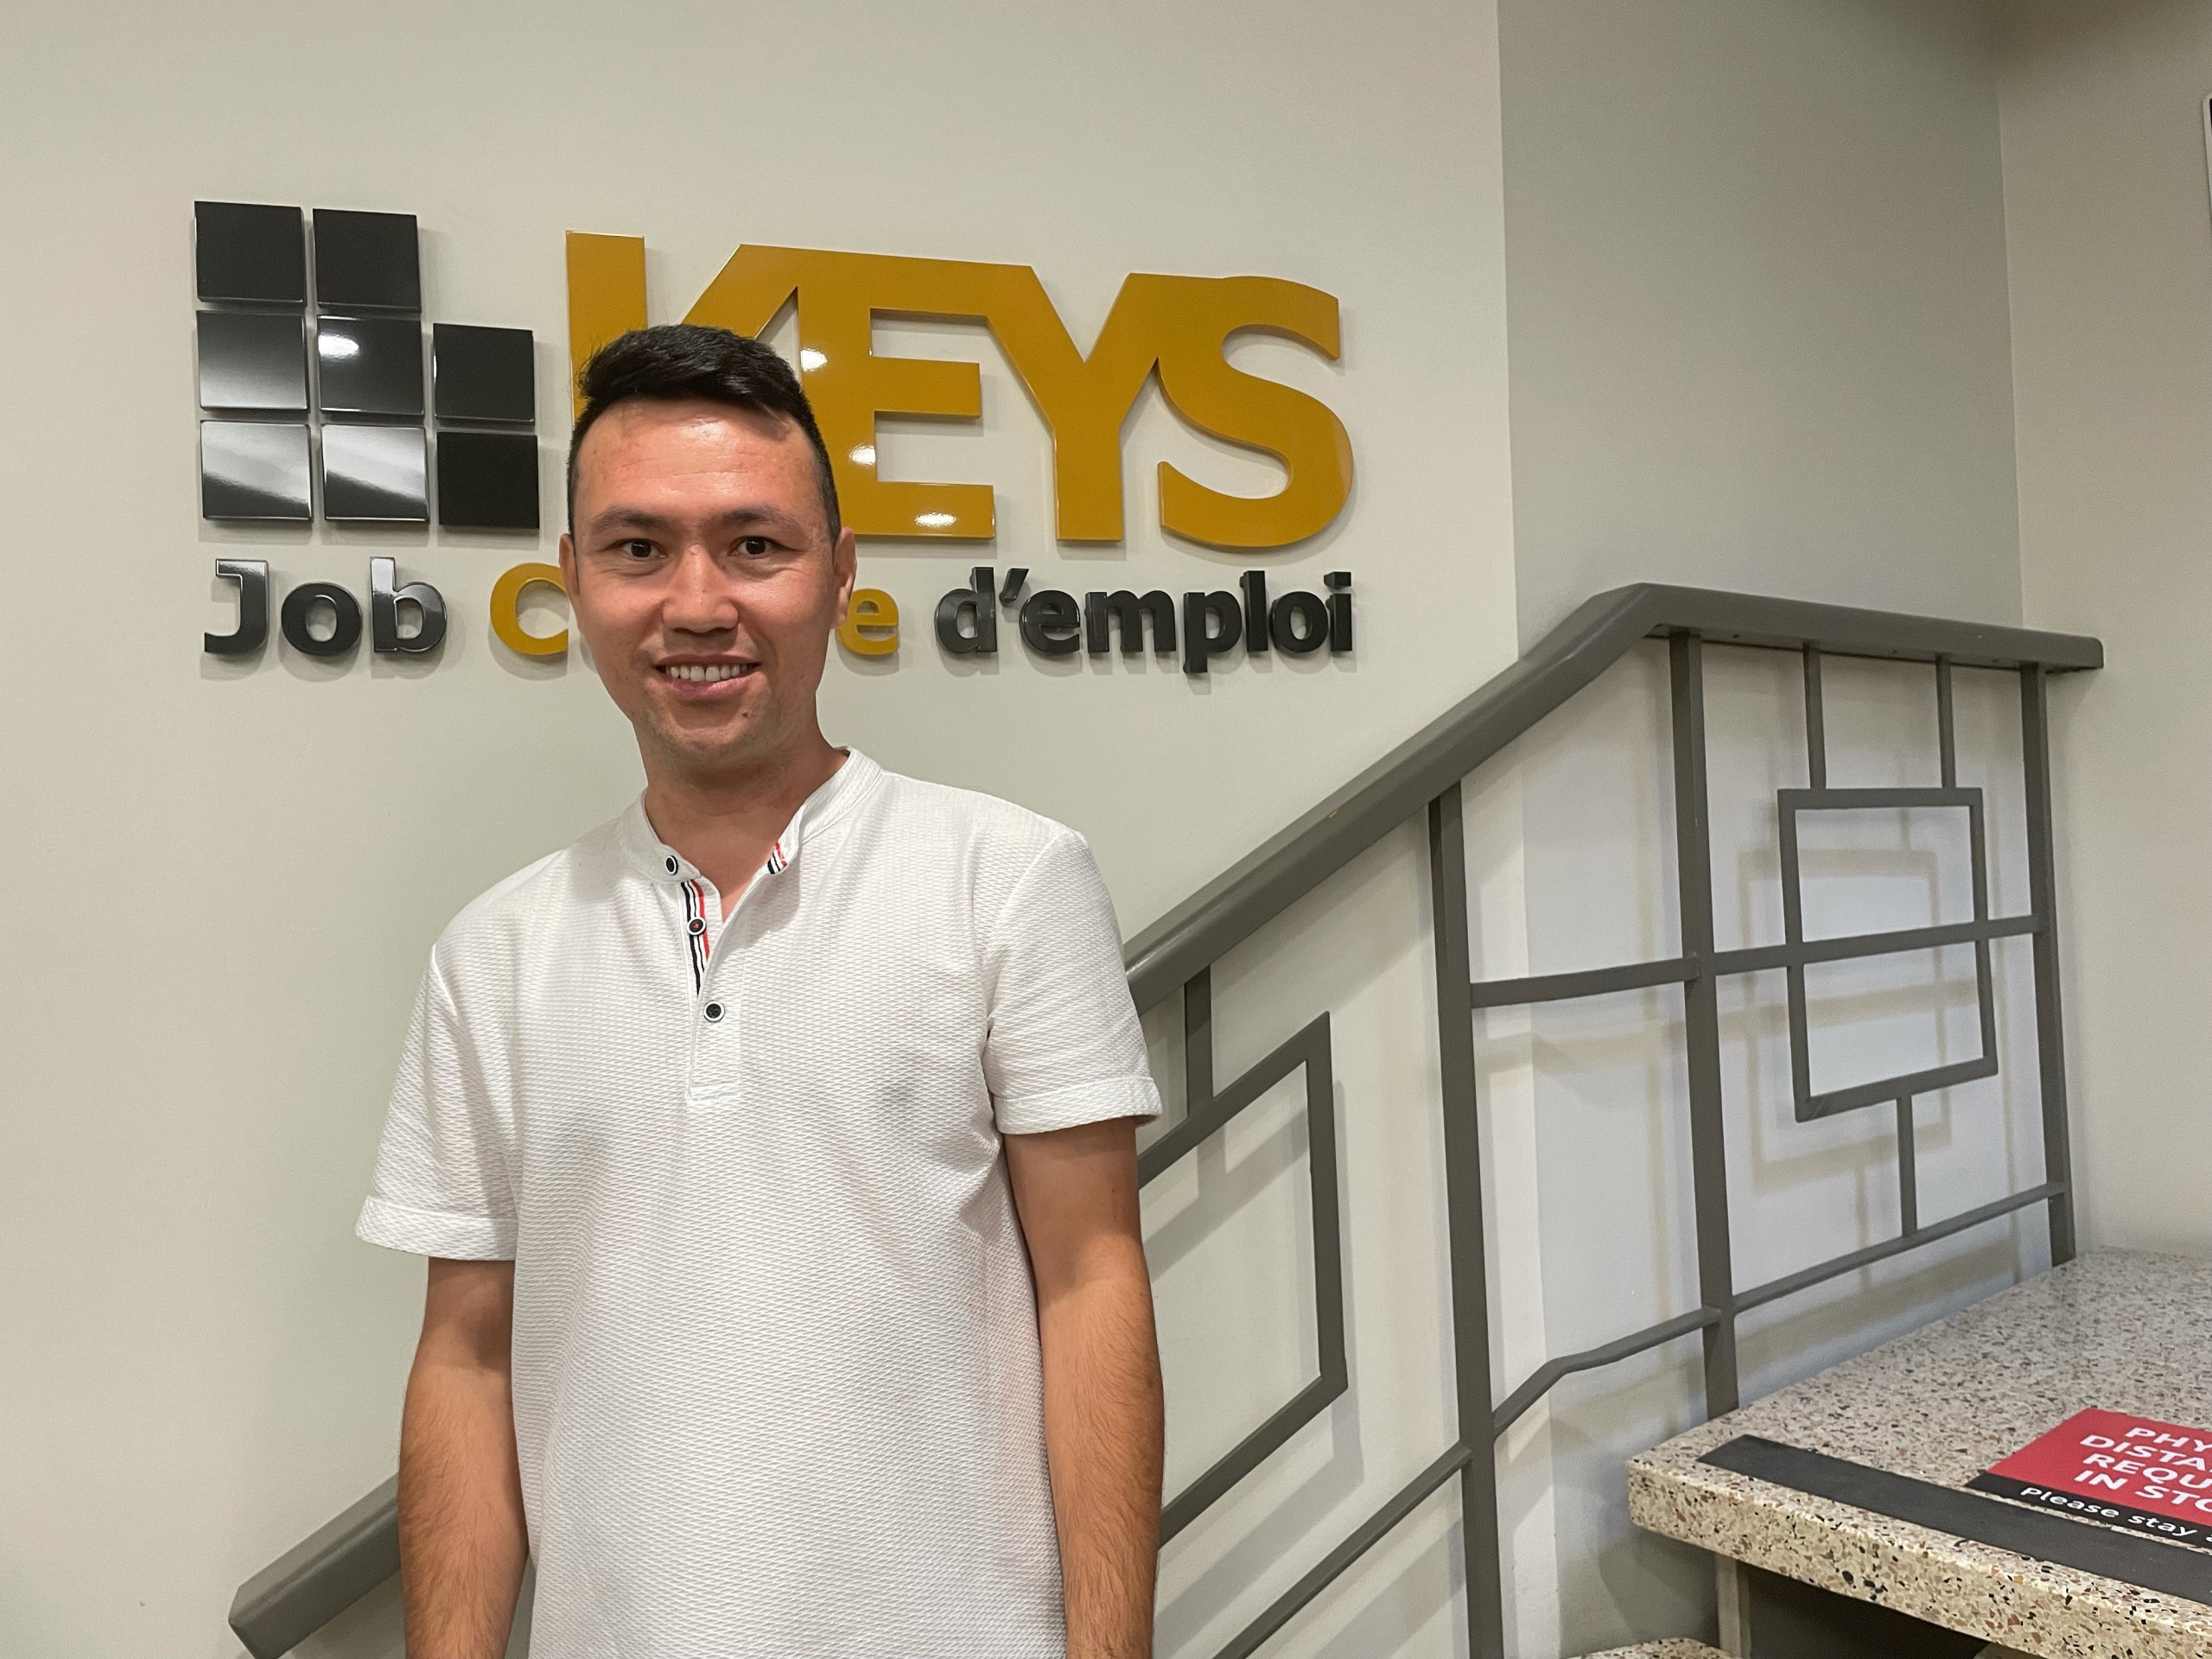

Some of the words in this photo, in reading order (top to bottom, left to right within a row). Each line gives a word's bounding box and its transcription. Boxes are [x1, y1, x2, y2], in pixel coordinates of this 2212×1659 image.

[204, 556, 448, 657] Job
[934, 566, 1353, 674] d'emploi
[2079, 1434, 2212, 1472] DISTA
[2074, 1470, 2128, 1491] IN
[2020, 1486, 2120, 1518] Please
[2127, 1515, 2198, 1536] stay
